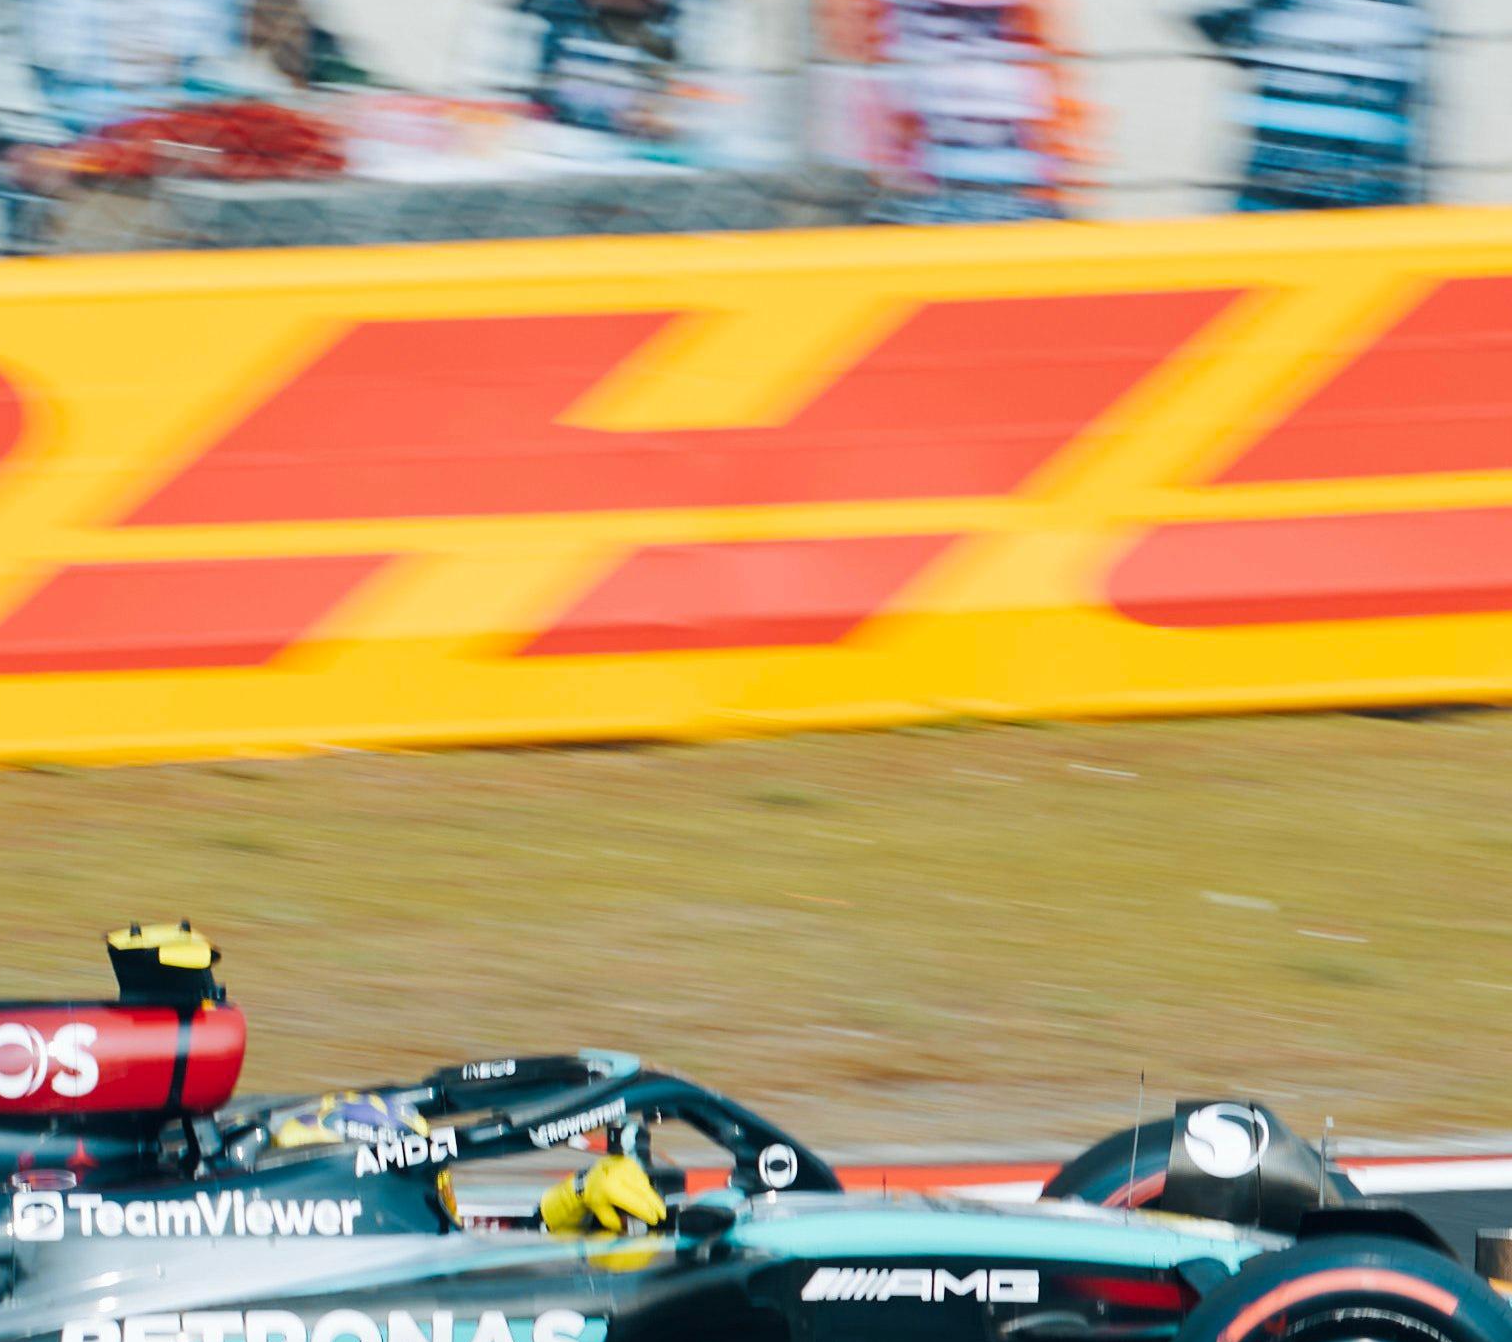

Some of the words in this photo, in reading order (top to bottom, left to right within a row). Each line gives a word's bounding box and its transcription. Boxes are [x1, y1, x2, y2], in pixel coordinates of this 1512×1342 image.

[355, 1133, 430, 1178] AMD
[67, 1189, 362, 1237] TeamViewer
[878, 1267, 1040, 1304] AMG
